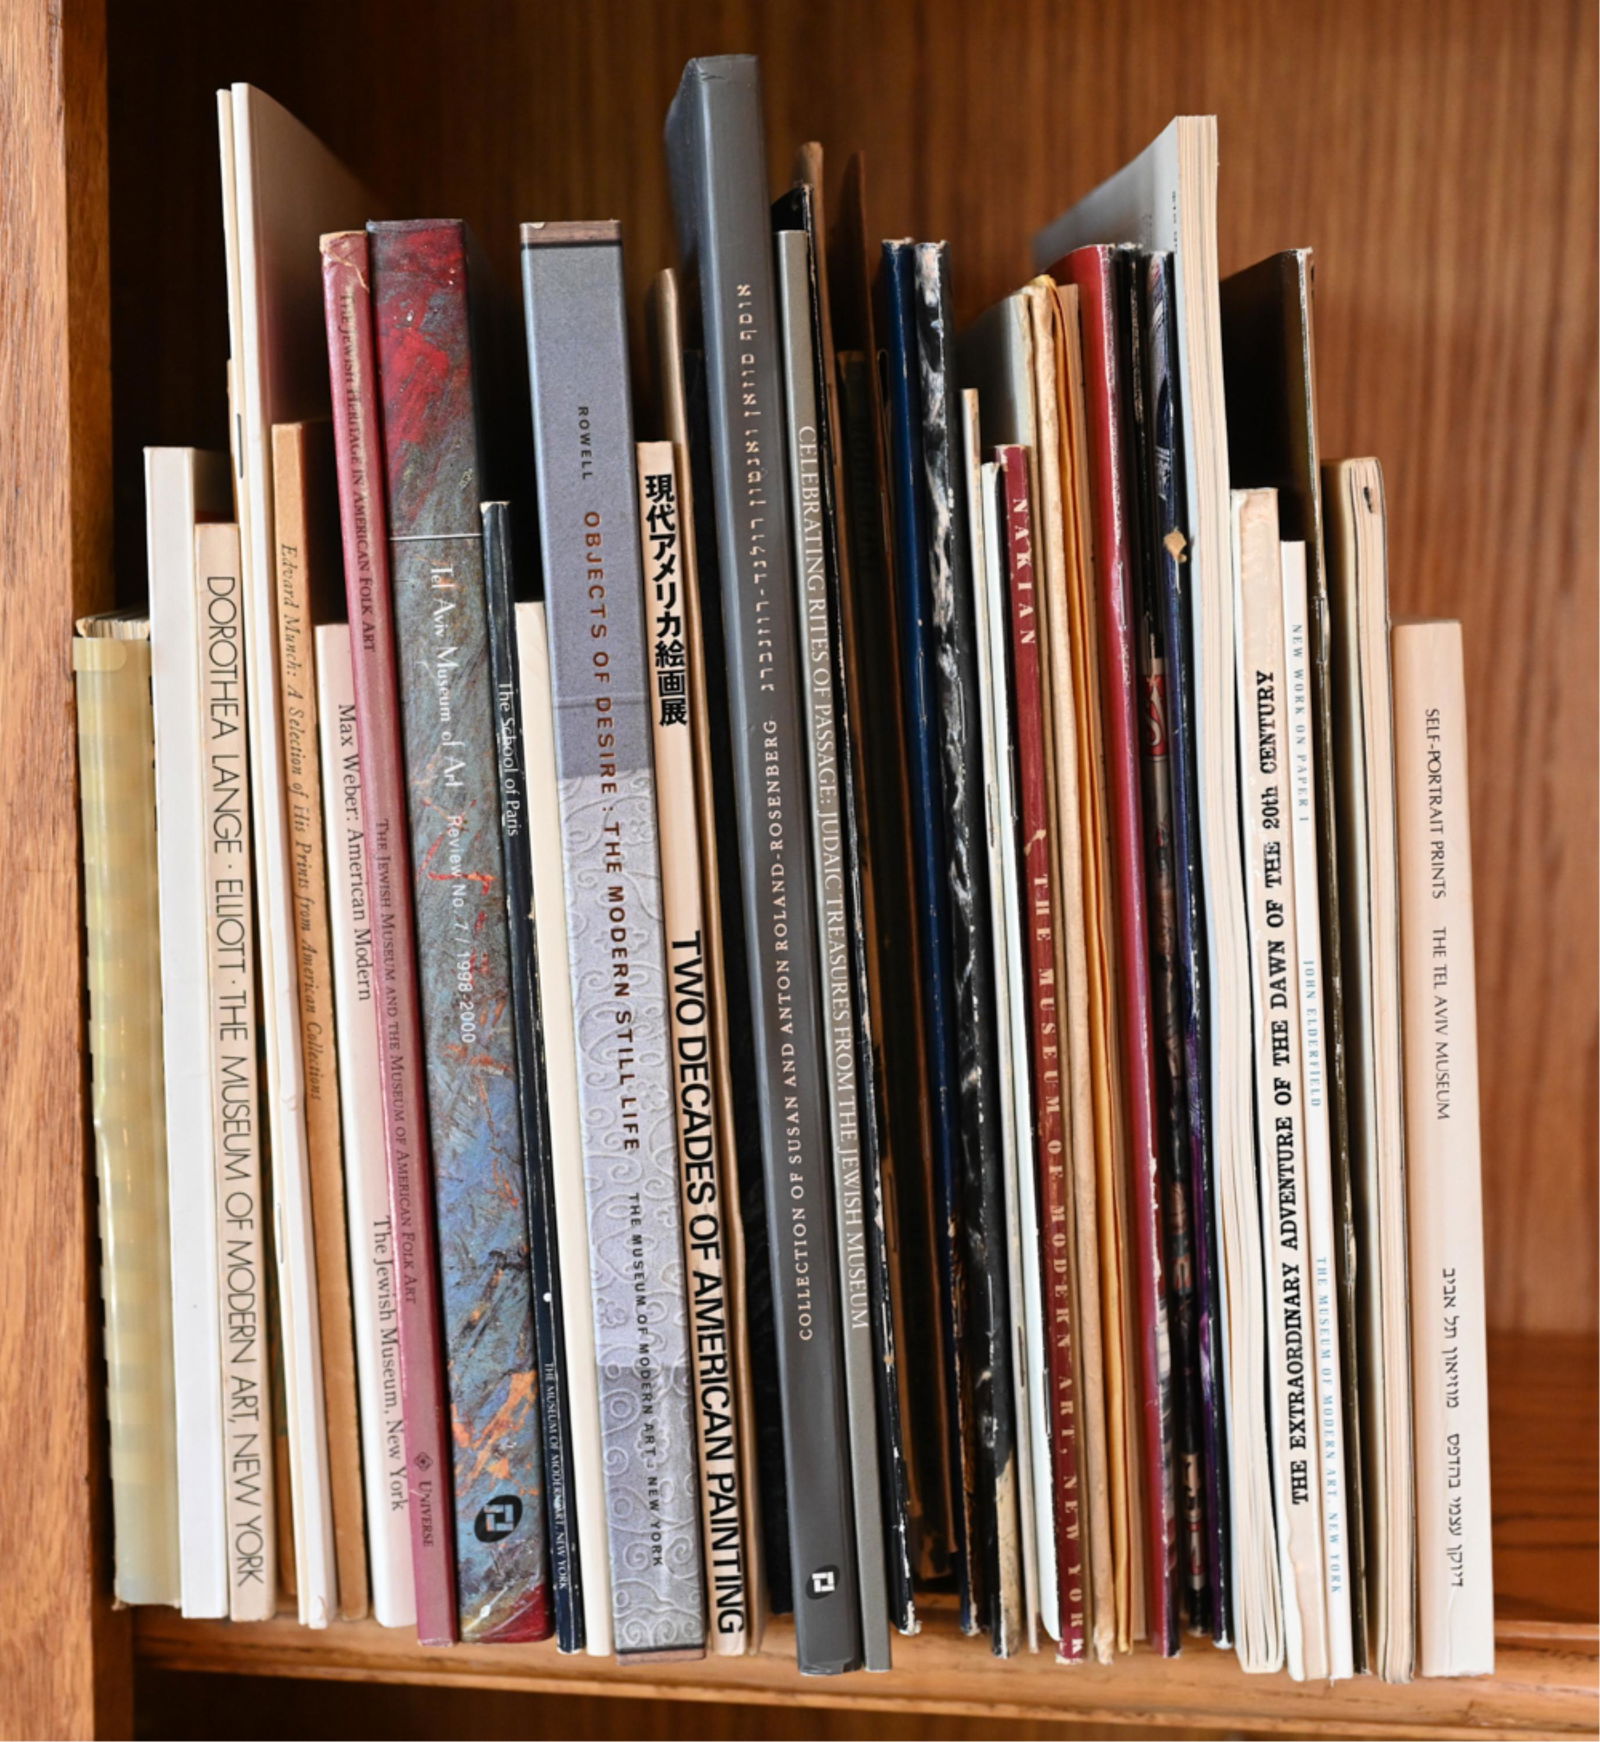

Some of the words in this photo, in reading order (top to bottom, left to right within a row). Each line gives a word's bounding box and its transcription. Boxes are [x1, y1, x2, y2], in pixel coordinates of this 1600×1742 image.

[736, 284, 756, 340] אוסף
[339, 326, 359, 383] JEWISH
[740, 353, 760, 416] סוזאן
[346, 388, 366, 464] HERITAGE
[578, 406, 593, 480] ROWELL
[350, 469, 367, 485] IN
[744, 428, 766, 506] ואנטון
[352, 491, 372, 571] AMERICAN
[796, 425, 825, 590] CELEBRATING
[281, 544, 300, 606] Edvard
[356, 577, 374, 615] FOLK
[428, 564, 454, 588] Tel
[583, 511, 608, 638] OBJECTS
[1012, 498, 1037, 645] NAKIAN
[431, 598, 458, 637] Aviv
[644, 474, 688, 728] 現代アメリカ絵画展
[747, 518, 774, 690] רולנד-רוזנברג
[207, 576, 240, 739] DOROTHEA
[284, 614, 303, 677] Munch:
[359, 622, 376, 652] ART
[807, 598, 829, 662] RITES
[1292, 624, 1305, 658] NEW
[288, 684, 304, 697] A
[434, 646, 463, 722] Museum
[592, 650, 611, 684] OF
[811, 668, 831, 697] OF
[1293, 668, 1306, 716] WORK
[338, 704, 357, 746] Max
[498, 682, 514, 712] The
[1255, 670, 1278, 774] CENTURY
[289, 706, 308, 775] Selection
[440, 731, 464, 748] of
[500, 716, 518, 772] School
[595, 697, 618, 794] DESIRE
[813, 703, 838, 803] PASSAGE:
[1295, 724, 1307, 744] ON
[288, 782, 308, 796] of
[341, 754, 361, 820] Weber:
[442, 756, 467, 787] Art
[504, 779, 519, 795] of
[1296, 754, 1309, 808] PAPER
[1425, 708, 1444, 834] SELF-PORTRAIT
[212, 755, 243, 853] LANGE
[294, 804, 310, 832] His
[505, 801, 520, 837] Paris
[1260, 786, 1280, 829] 20th
[375, 819, 390, 851] THE
[446, 815, 466, 876] Review
[603, 822, 623, 873] THE
[761, 720, 790, 951] ROLAND-ROSENBERG
[816, 810, 843, 888] JUDAIC
[295, 841, 313, 888] Prints
[346, 829, 368, 922] American
[375, 855, 393, 907] JEWISH
[1262, 840, 1282, 888] THE
[1430, 840, 1446, 898] PRINTS
[215, 880, 246, 973] ELLIOTT
[295, 894, 316, 931] from
[454, 920, 469, 930] 7
[1033, 873, 1051, 941] THE
[1265, 898, 1284, 928] OF
[352, 928, 373, 1000] Modern
[380, 913, 398, 980] MUSEUM
[607, 886, 631, 997] MODERN
[825, 894, 851, 1020] TREASURES
[1432, 926, 1447, 958] THE
[301, 939, 321, 1013] American
[385, 986, 398, 1016] AND
[455, 950, 476, 1043] 1998-2000
[670, 930, 707, 1026] TWO
[776, 958, 794, 1034] ANTON
[1266, 940, 1287, 1008] DAWN
[1304, 960, 1317, 1000] JOHN
[1433, 966, 1447, 990] TEL
[218, 990, 248, 1040] THE
[387, 1021, 400, 1050] THE
[1037, 968, 1060, 1115] MUSEUM
[1270, 1020, 1290, 1066] THE
[1434, 995, 1448, 1035] AVIV
[305, 1021, 325, 1101] Collections
[615, 1010, 636, 1084] STILL
[781, 1042, 797, 1086] AND
[833, 1026, 855, 1090] FROM
[1305, 1008, 1321, 1107] ELDERFIELD
[389, 1055, 406, 1121] MUSEUM
[1273, 1076, 1292, 1106] OF
[1435, 1041, 1451, 1120] MUSEUM
[220, 1056, 252, 1179] MUSEUM
[394, 1127, 406, 1145] OF
[620, 1096, 640, 1150] LIFE
[677, 1036, 718, 1204] DECADES
[784, 1095, 802, 1163] SUSAN
[837, 1095, 858, 1141] THE
[788, 1172, 804, 1200] OF
[836, 1146, 863, 1225] JEWISH
[1045, 1140, 1063, 1178] OF
[1275, 1116, 1298, 1250] ADVENTURE
[224, 1192, 253, 1230] OF
[396, 1150, 412, 1225] AMERICAN
[629, 1192, 642, 1226] THE
[373, 1215, 392, 1253] The
[401, 1231, 415, 1268] FOLK
[689, 1214, 722, 1260] OF
[374, 1257, 396, 1319] Jewish
[404, 1272, 417, 1302] ART
[631, 1234, 647, 1306] MUSEUM
[791, 1207, 813, 1340] COLLECTION
[846, 1232, 870, 1328] MUSEUM
[1049, 1204, 1071, 1348] MODERN
[1316, 1256, 1328, 1286] THE
[1441, 1268, 1457, 1309] אביב
[225, 1240, 257, 1363] MODERN
[636, 1314, 649, 1334] OF
[1318, 1294, 1331, 1358] MUSEUM
[1443, 1314, 1459, 1339] תל
[378, 1327, 403, 1413] Museum,
[543, 1362, 555, 1382] THE
[638, 1343, 654, 1414] MODERN
[692, 1270, 735, 1460] AMERICAN
[1280, 1263, 1307, 1449] EXTRAORDINARY
[1321, 1368, 1332, 1386] OF
[1441, 1347, 1460, 1408] מוזיאון
[227, 1375, 259, 1424] ART,
[545, 1385, 558, 1432] MUSEUM
[1055, 1376, 1075, 1454] ART,
[1322, 1394, 1335, 1459] MODERN
[386, 1418, 406, 1460] New
[548, 1435, 559, 1450] OF
[643, 1422, 656, 1456] ART
[1446, 1433, 1461, 1488] בהדפס
[231, 1434, 261, 1506] NEW
[389, 1465, 409, 1510] York
[646, 1476, 660, 1510] NEW
[1289, 1460, 1308, 1504] THE
[419, 1480, 435, 1546] UNIVERSE
[1062, 1476, 1080, 1540] NEW
[1327, 1512, 1339, 1545] NEW
[1447, 1498, 1463, 1536] עצמי
[233, 1515, 263, 1587] YORK
[554, 1532, 566, 1556] NEW
[649, 1521, 663, 1567] YORK
[705, 1471, 746, 1634] PAINTING
[1446, 1544, 1464, 1587] דיוקן
[556, 1560, 568, 1589] YORK
[1328, 1552, 1341, 1593] YORK
[1067, 1564, 1086, 1654] YORK
